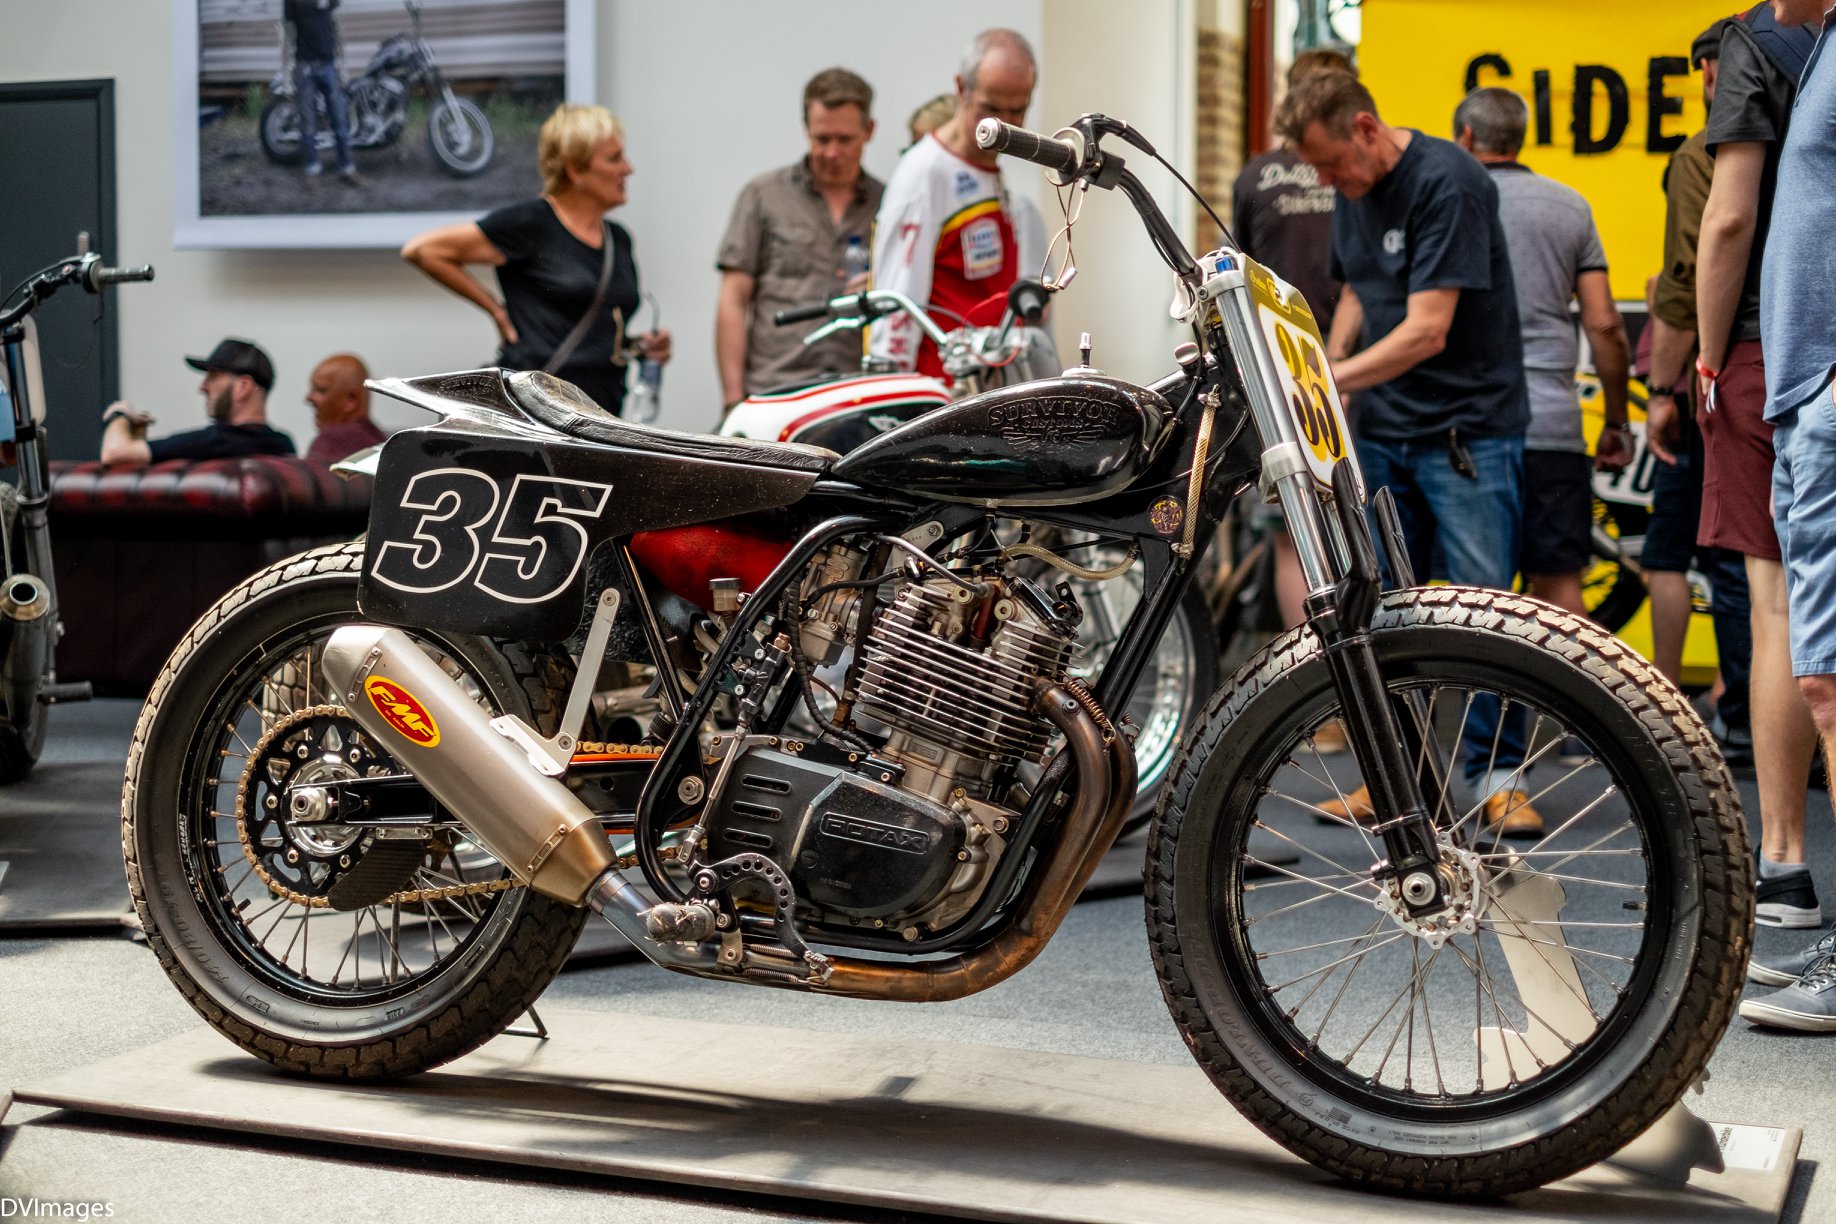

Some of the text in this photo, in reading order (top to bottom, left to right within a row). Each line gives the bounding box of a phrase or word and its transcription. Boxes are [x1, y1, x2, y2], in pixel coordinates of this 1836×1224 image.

[902, 224, 921, 268] 7
[988, 397, 1121, 427] SURVIVOR
[371, 467, 613, 604] 35
[368, 686, 436, 738] FMF
[825, 817, 926, 851] ROTAX
